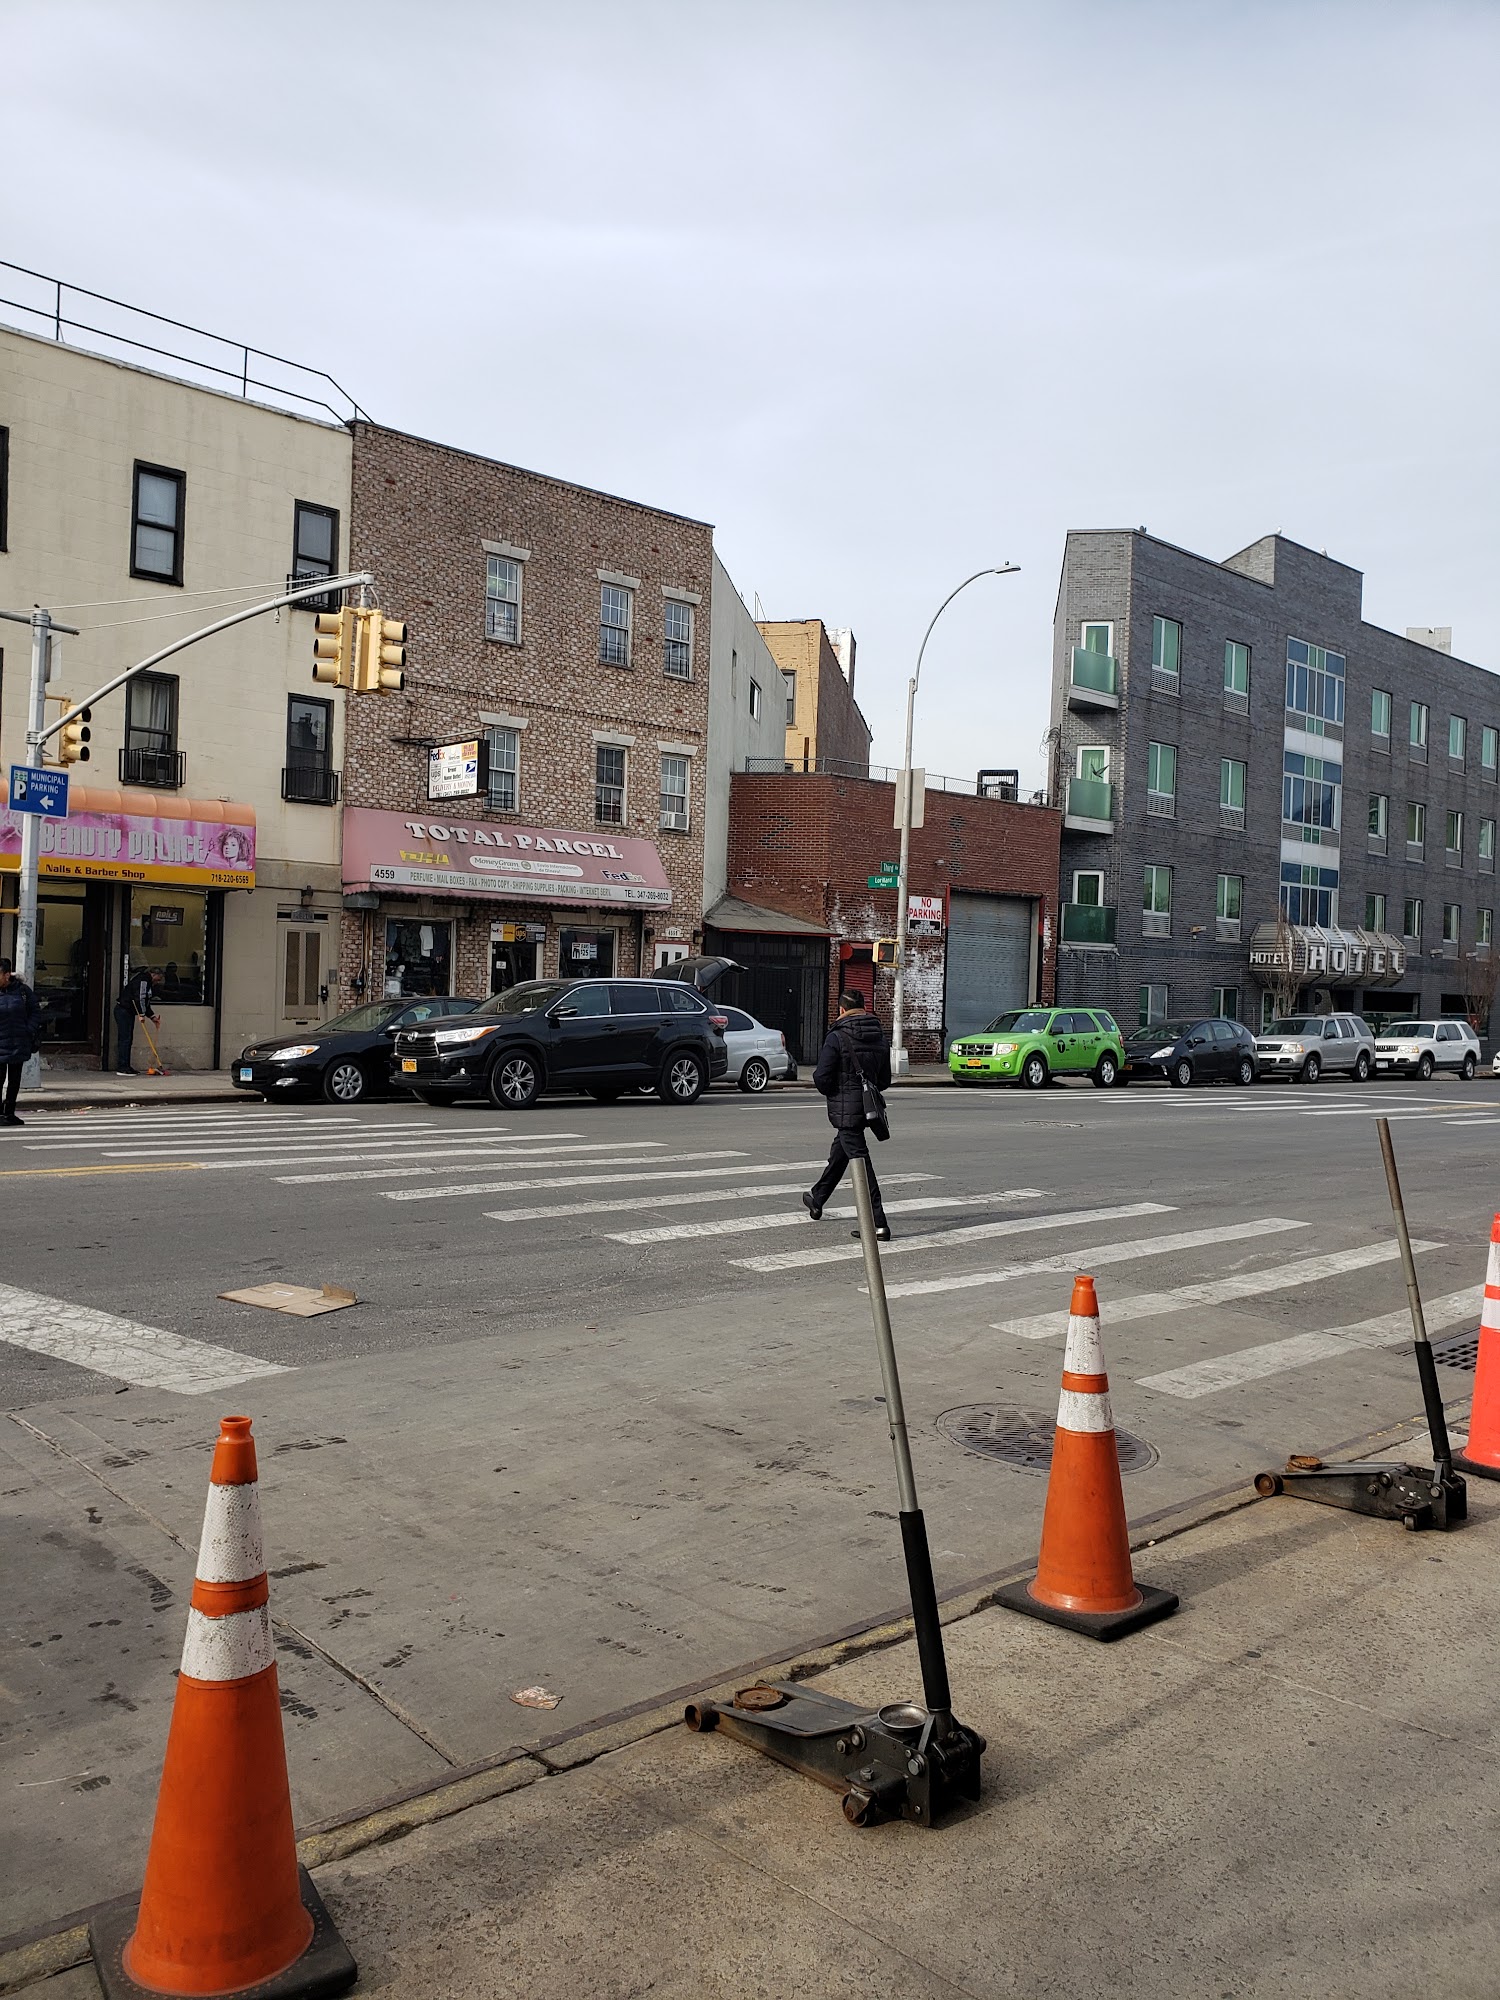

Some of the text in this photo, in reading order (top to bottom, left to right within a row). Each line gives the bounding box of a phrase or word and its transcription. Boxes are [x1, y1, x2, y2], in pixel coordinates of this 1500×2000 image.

[31, 772, 66, 786] MUNICIPAL
[30, 782, 59, 795] PARKING
[41, 822, 122, 858] BEAUTY
[129, 829, 206, 864] PALACE
[404, 821, 624, 860] TOTAL PARCEL
[45, 864, 145, 880] Nails & Barber Shop
[374, 868, 395, 879] 4559
[883, 863, 894, 873] Third
[602, 870, 646, 883] FedEx
[409, 871, 434, 883] PERFUME
[436, 874, 449, 884] MAIL
[450, 875, 465, 886] BOXES
[468, 878, 478, 887] FAX
[481, 878, 497, 888] PHOTO
[497, 879, 510, 889] COPY
[512, 881, 534, 891] SHIPPING
[534, 882, 555, 892] SUPPLIES
[558, 884, 577, 895] PACKING
[579, 885, 600, 896] INTERNET
[636, 891, 669, 901] 347-269-8032
[921, 897, 932, 908] NO
[908, 908, 941, 920] PARKING
[1250, 946, 1405, 973] HOTEL HOTEL
